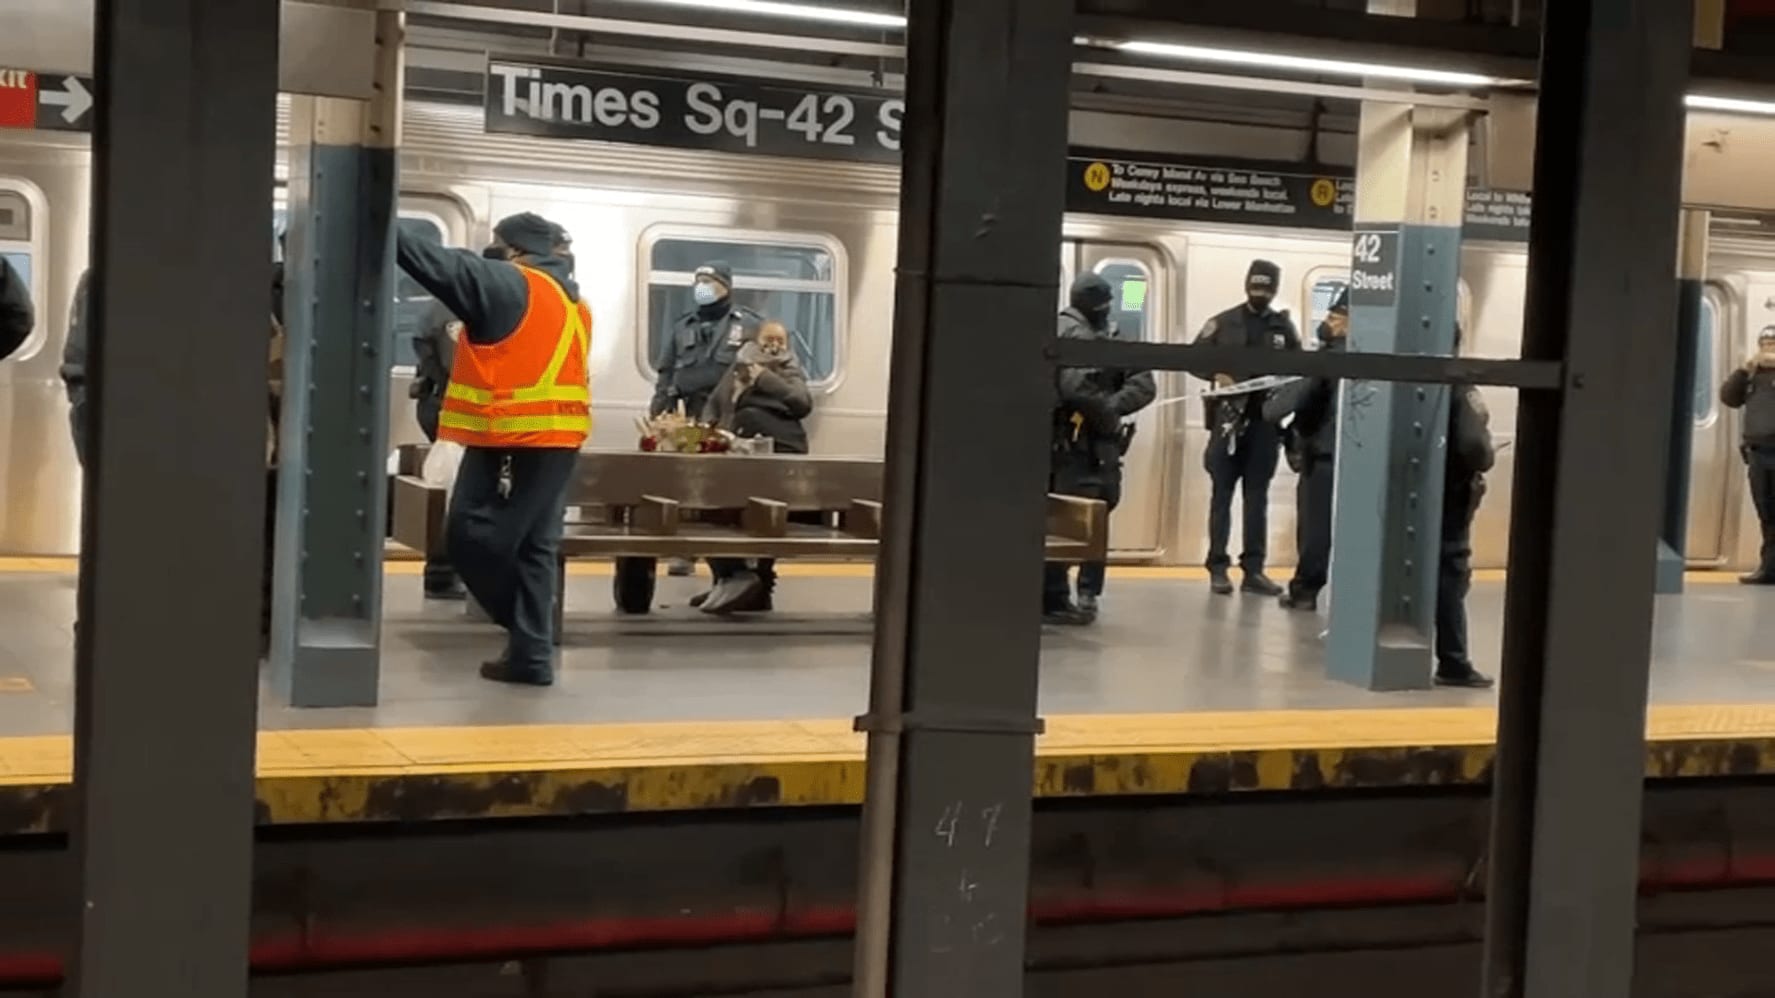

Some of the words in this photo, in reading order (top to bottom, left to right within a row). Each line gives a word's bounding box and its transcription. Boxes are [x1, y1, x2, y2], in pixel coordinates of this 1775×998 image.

[490, 64, 660, 129] Times
[684, 82, 855, 147] Sq-42
[876, 99, 905, 151] S
[1111, 163, 1124, 175] To
[1126, 164, 1159, 179] Coney
[1162, 166, 1192, 180] Island
[1111, 177, 1162, 192] Weekdays
[1210, 186, 1260, 198] weekends
[1467, 191, 1491, 201] Local
[1108, 191, 1132, 202] Late
[1134, 193, 1164, 206] nights
[1212, 197, 1242, 210] Lower
[1244, 200, 1296, 214] Manhattan
[1355, 233, 1381, 263] 42
[1352, 270, 1394, 290] Street
